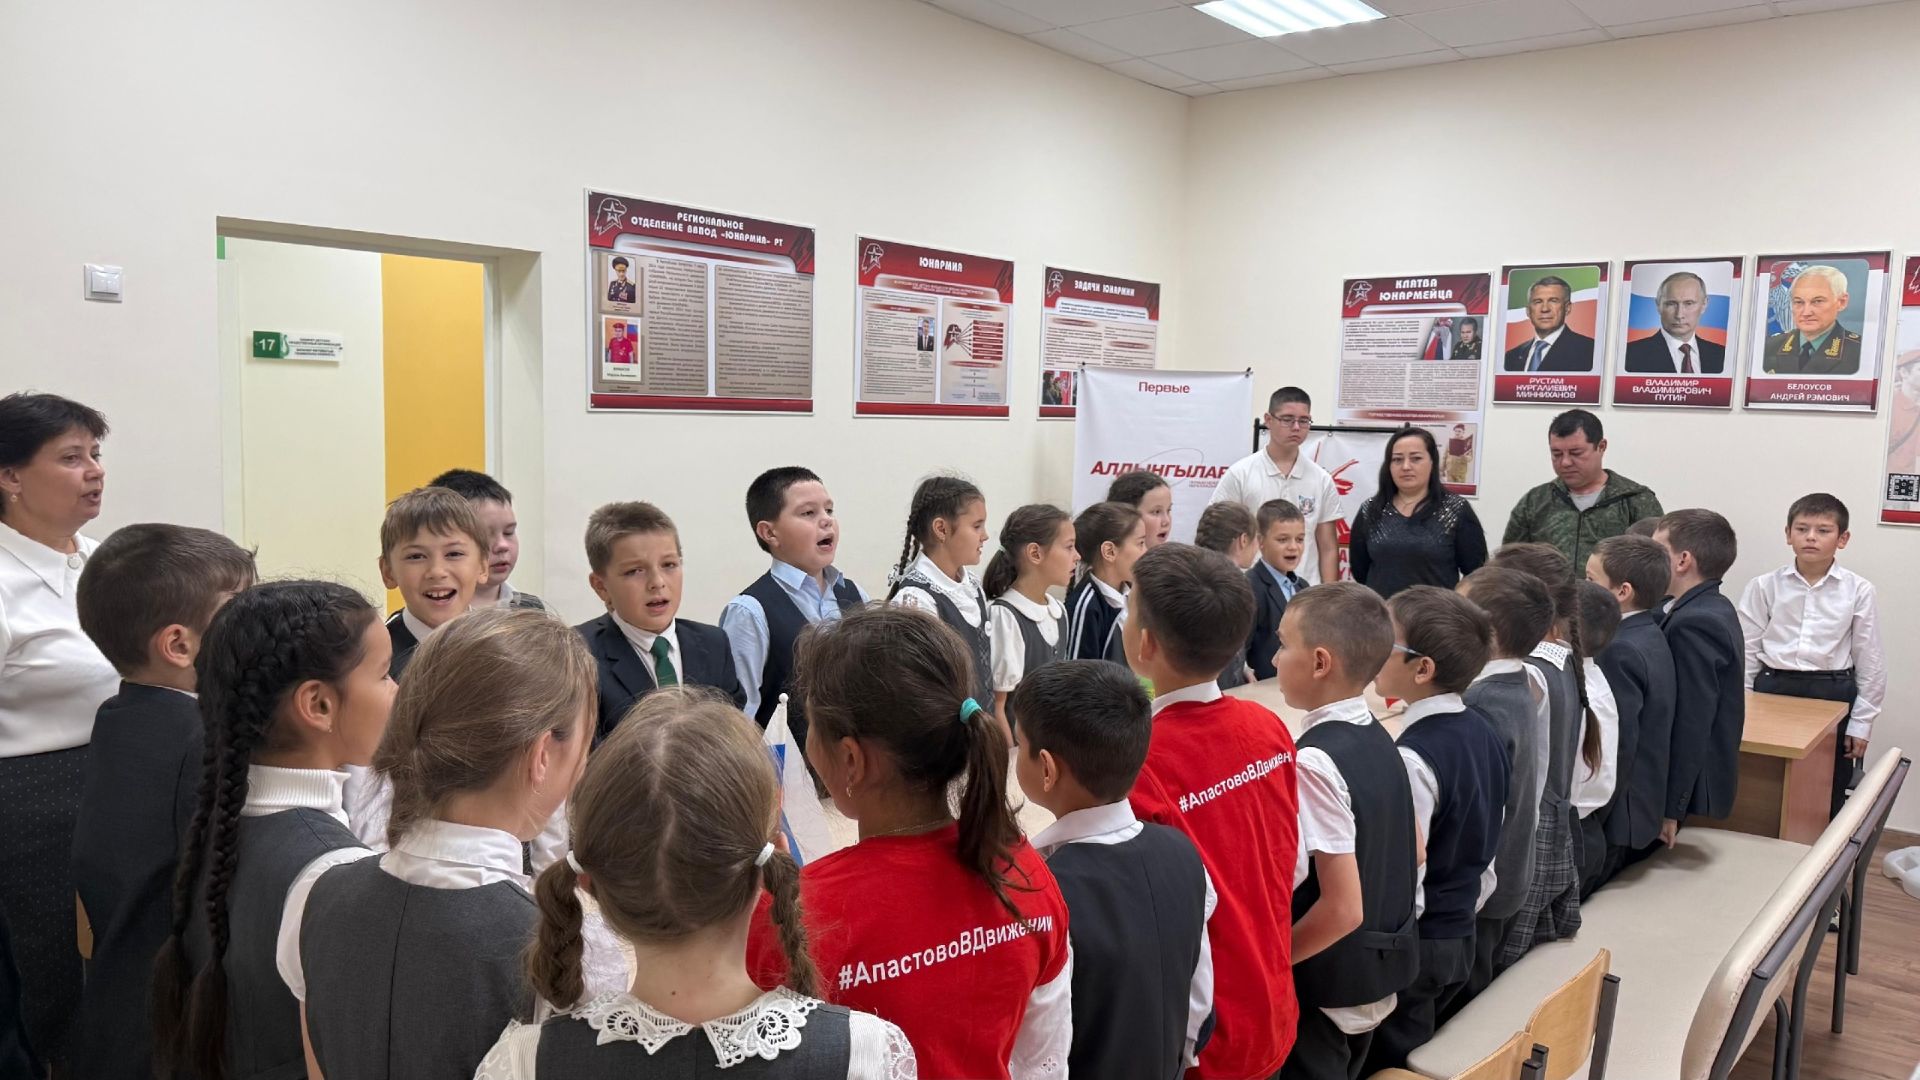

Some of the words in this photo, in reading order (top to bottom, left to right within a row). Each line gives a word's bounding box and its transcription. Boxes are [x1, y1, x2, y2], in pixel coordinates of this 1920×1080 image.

[677, 212, 744, 230] РЕГИОНАЛЬНОЕ
[631, 216, 684, 232] ОТДЕЛЕНИЕ
[774, 238, 783, 246] РТ
[919, 256, 963, 272] ЮНАРМИЯ
[1074, 280, 1100, 293] ЗАДАЧИ
[1102, 284, 1135, 297] ЮНАРМИИ
[1379, 289, 1453, 301] ЮНАРМЕЙЦА
[259, 338, 276, 351] 17
[1138, 381, 1190, 394] Первые
[1645, 379, 1699, 387] ВЛАДИМИР
[1787, 383, 1832, 391] БЕЛОУСОВ
[1632, 386, 1711, 394] ВЛАДИМИРОВИЧ
[1770, 392, 1804, 400] АНДРЕЙ
[1805, 393, 1850, 401] РЭМОВИЧ
[1178, 751, 1292, 813] #АпастовоВДвижен
[838, 915, 1053, 991] #АпастовоВДвижении
